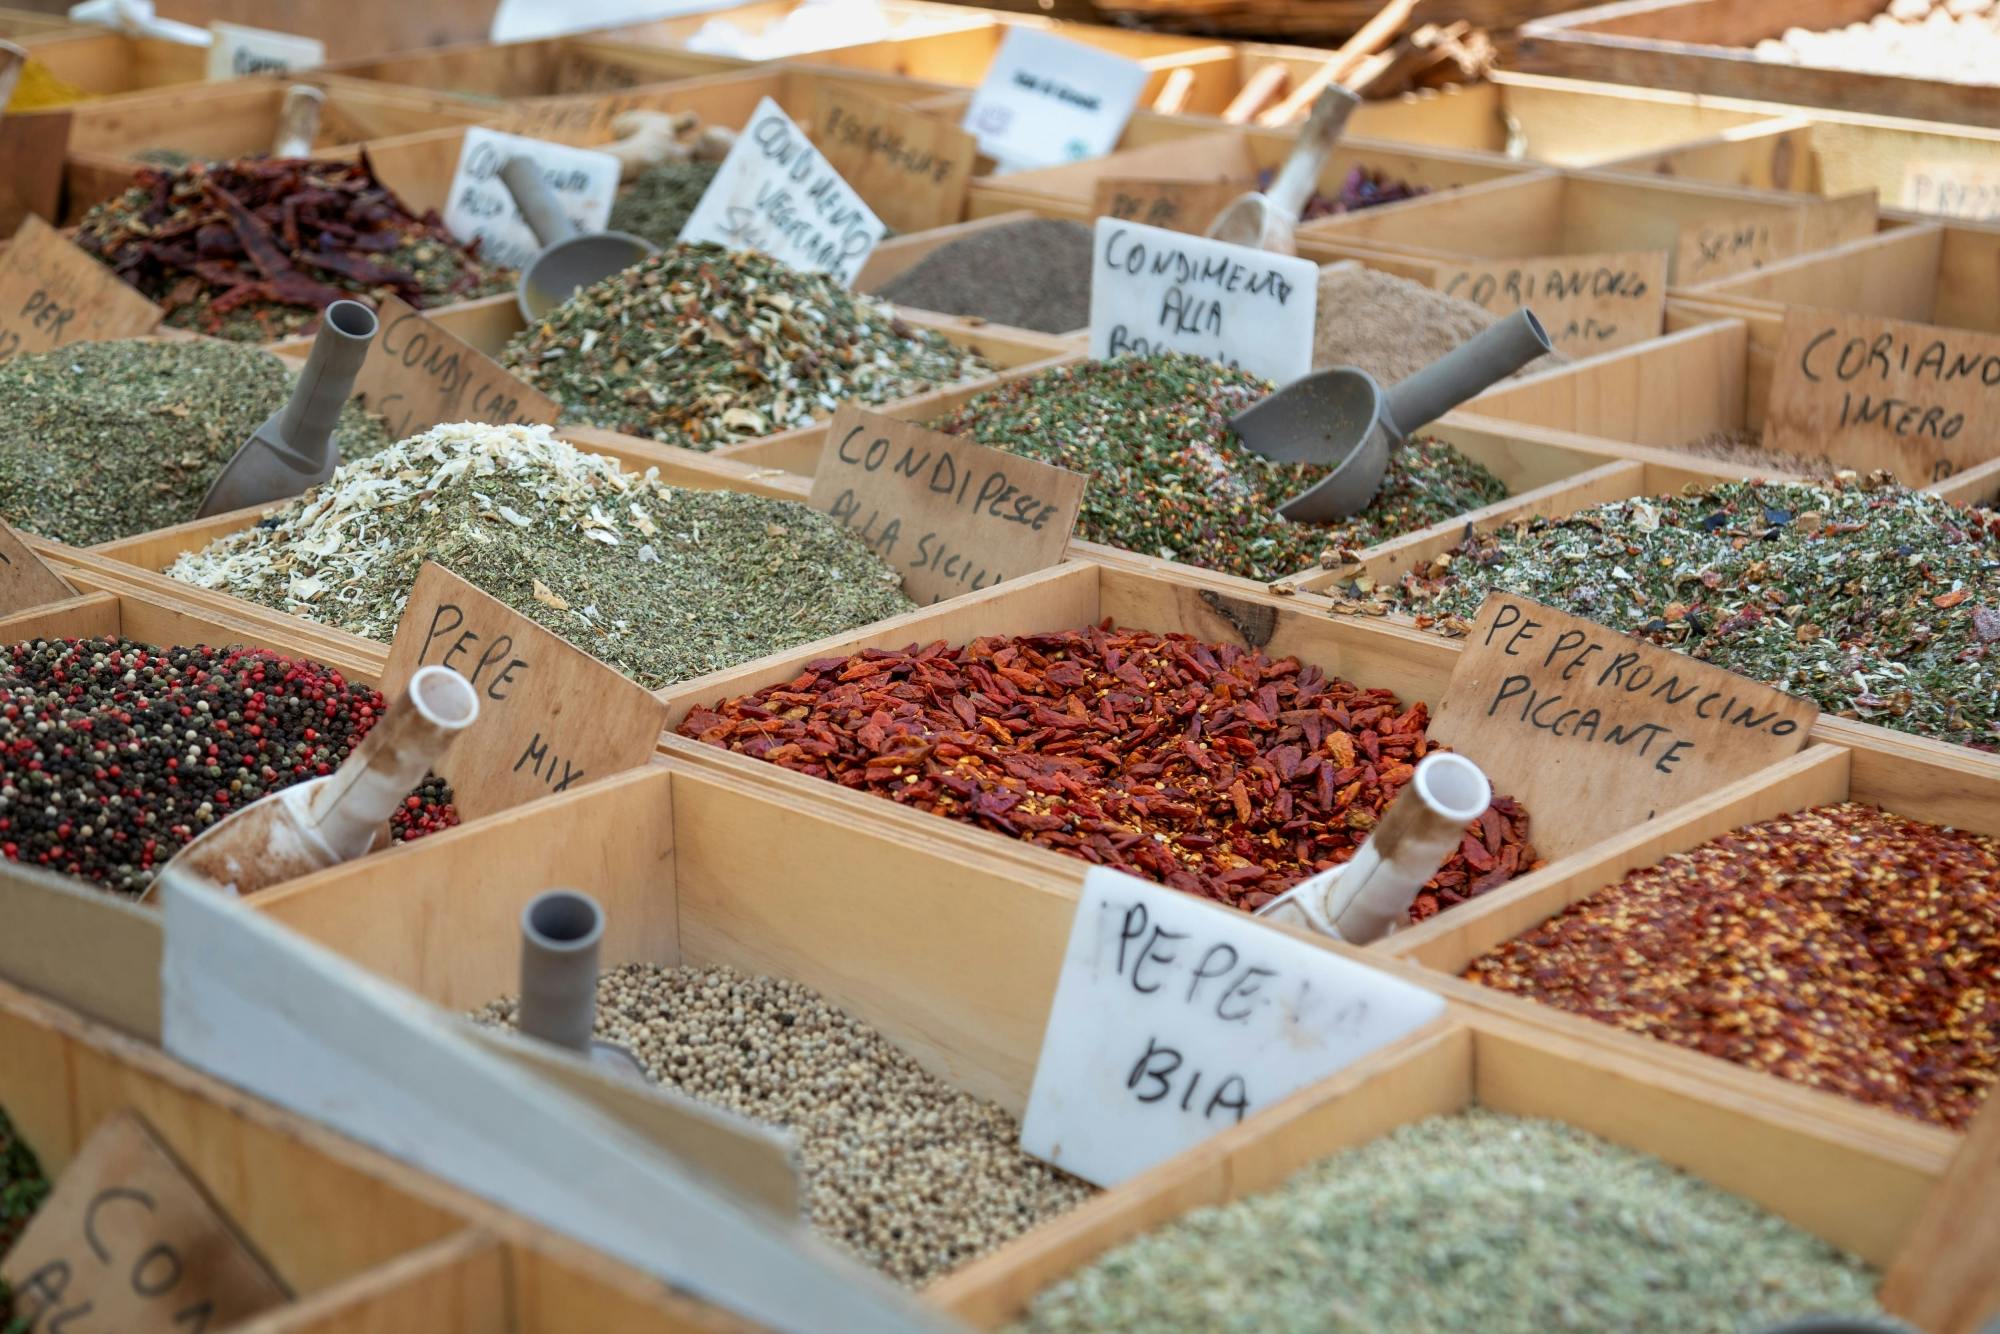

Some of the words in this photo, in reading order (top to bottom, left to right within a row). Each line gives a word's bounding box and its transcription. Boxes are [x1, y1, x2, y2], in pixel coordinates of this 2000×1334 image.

[1104, 228, 1293, 305] CONDIMENTO
[19, 288, 76, 343] PER
[1158, 286, 1222, 336] ALLA
[381, 312, 474, 395] CONDI
[1839, 391, 1965, 440] INTERO
[417, 603, 529, 701] PEPE
[512, 732, 585, 794] MIX
[1486, 674, 1696, 775] PICCANTE
[1116, 901, 1280, 1022] PEPE
